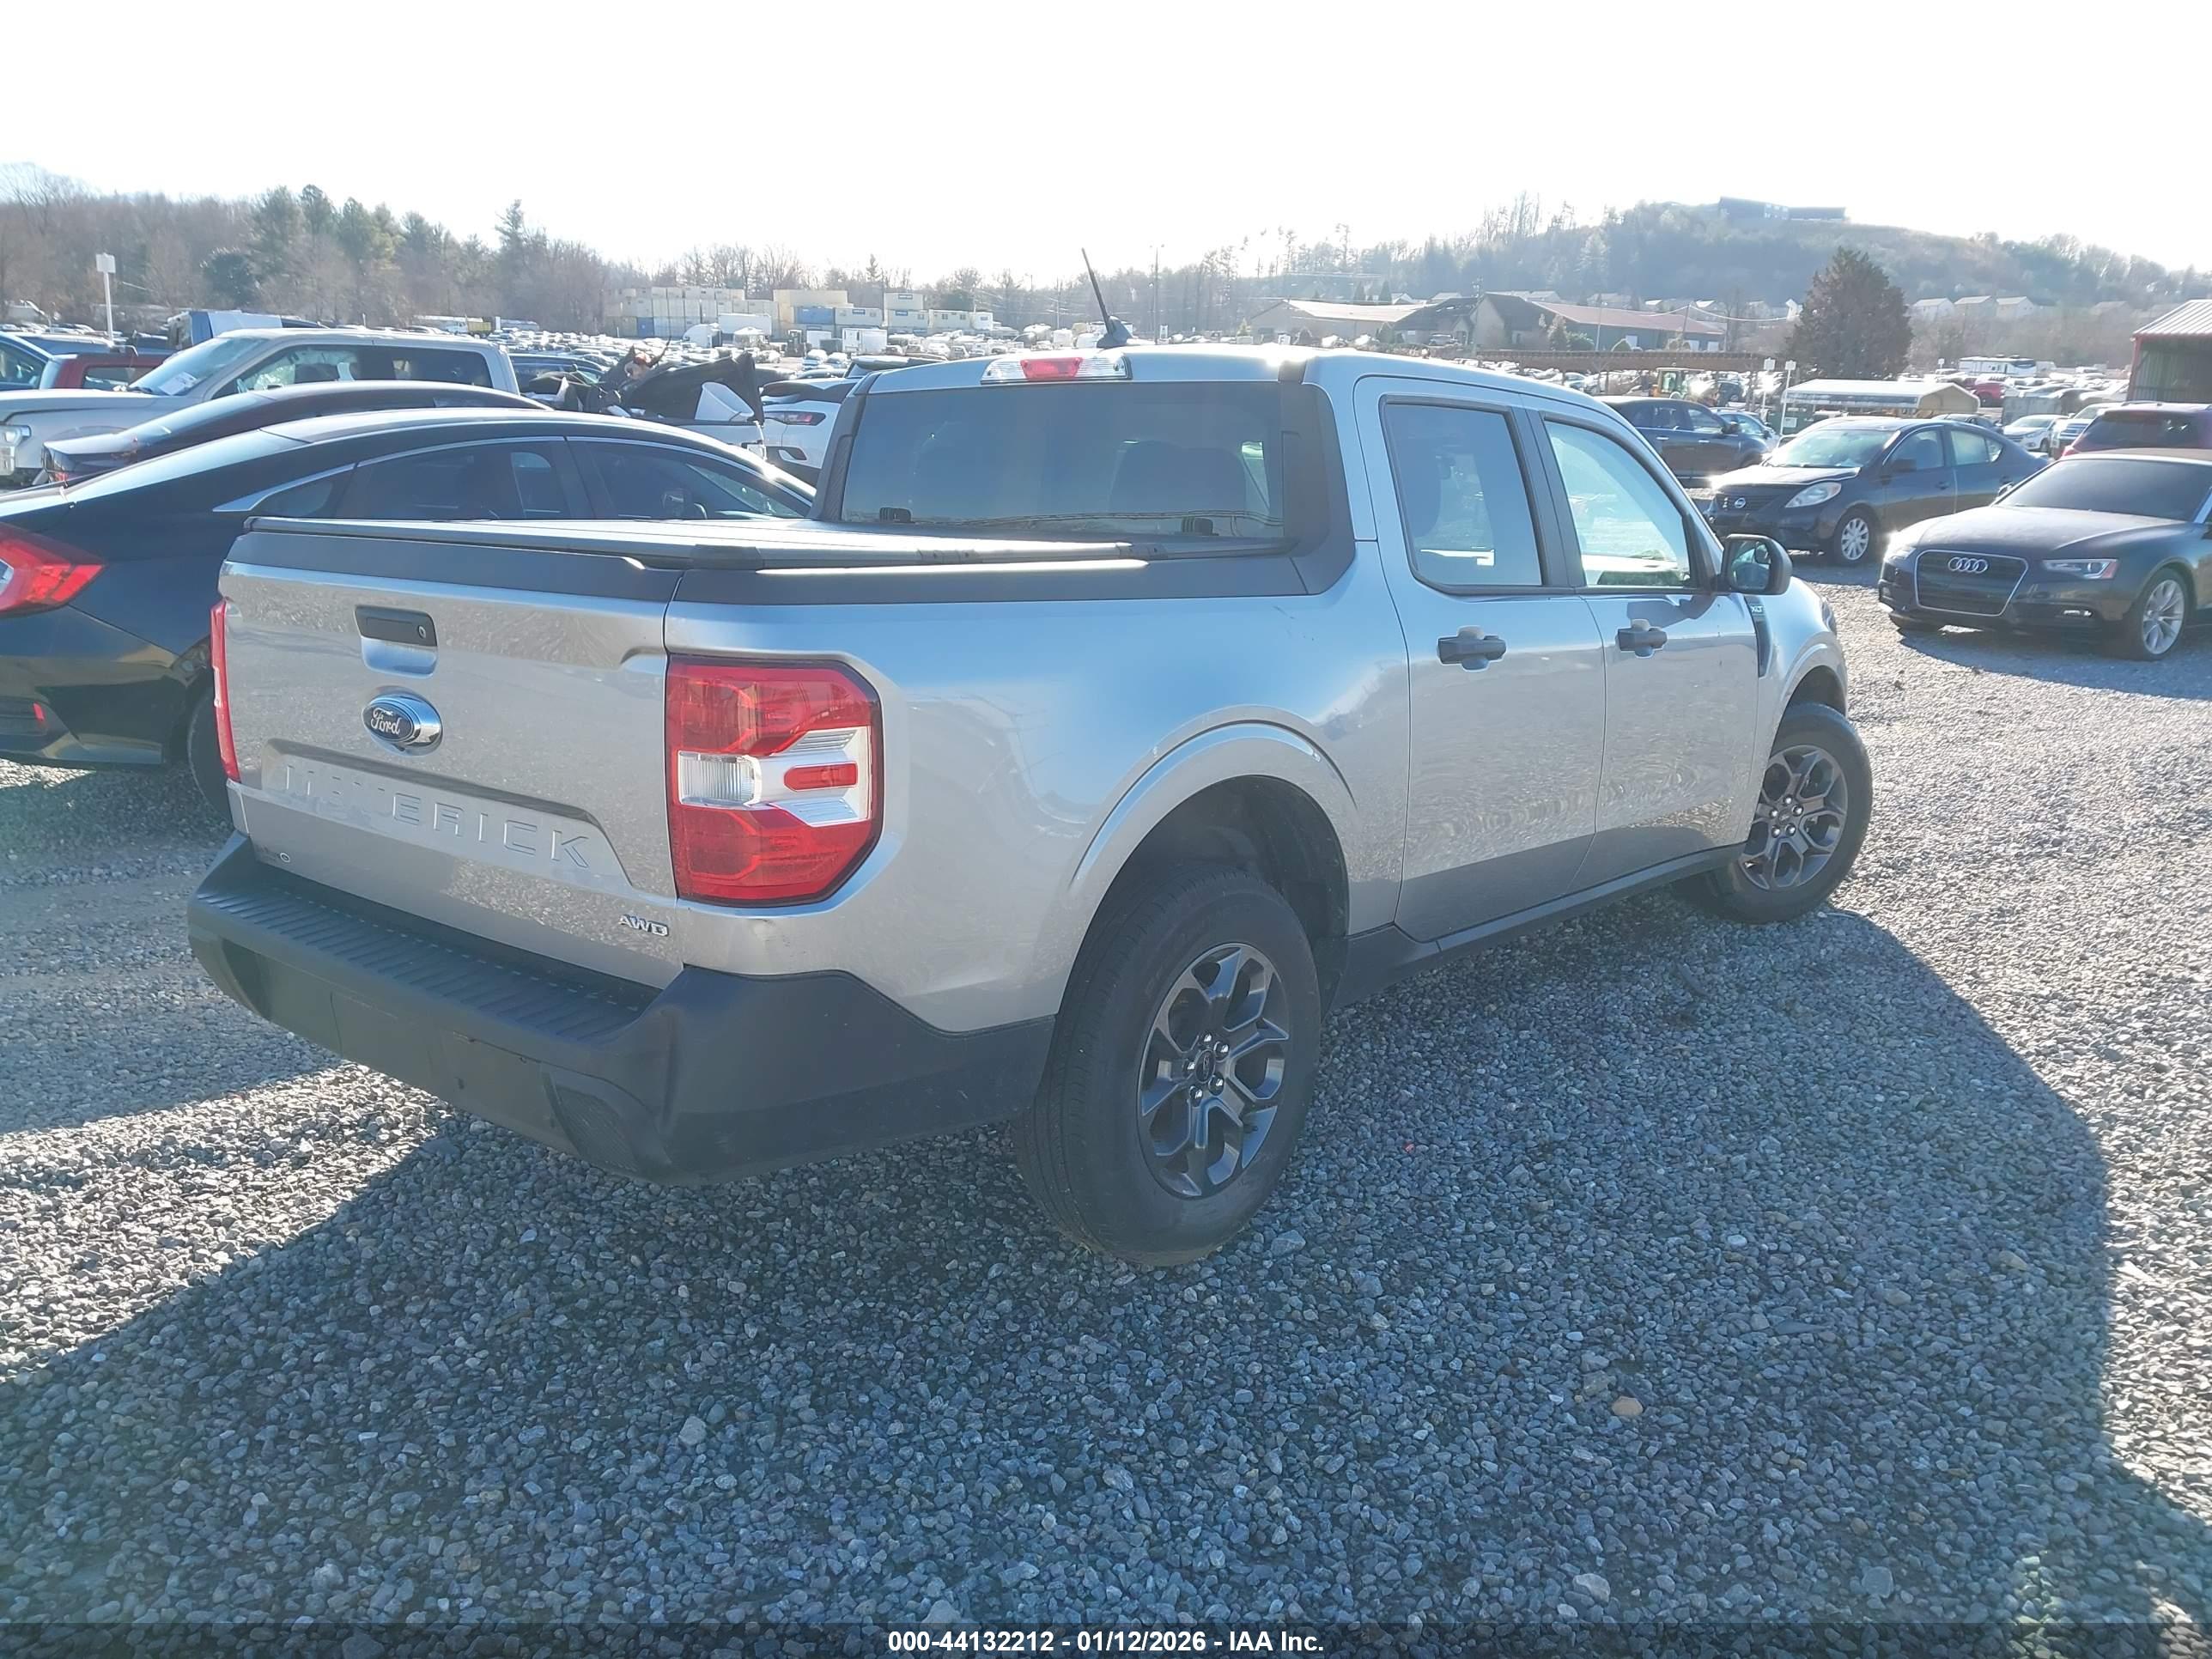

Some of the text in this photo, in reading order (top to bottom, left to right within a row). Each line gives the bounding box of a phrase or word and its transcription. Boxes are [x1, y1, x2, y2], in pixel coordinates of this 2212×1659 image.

[370, 707, 403, 735] Ford
[286, 764, 589, 868] MERICK
[618, 914, 669, 937] AWD
